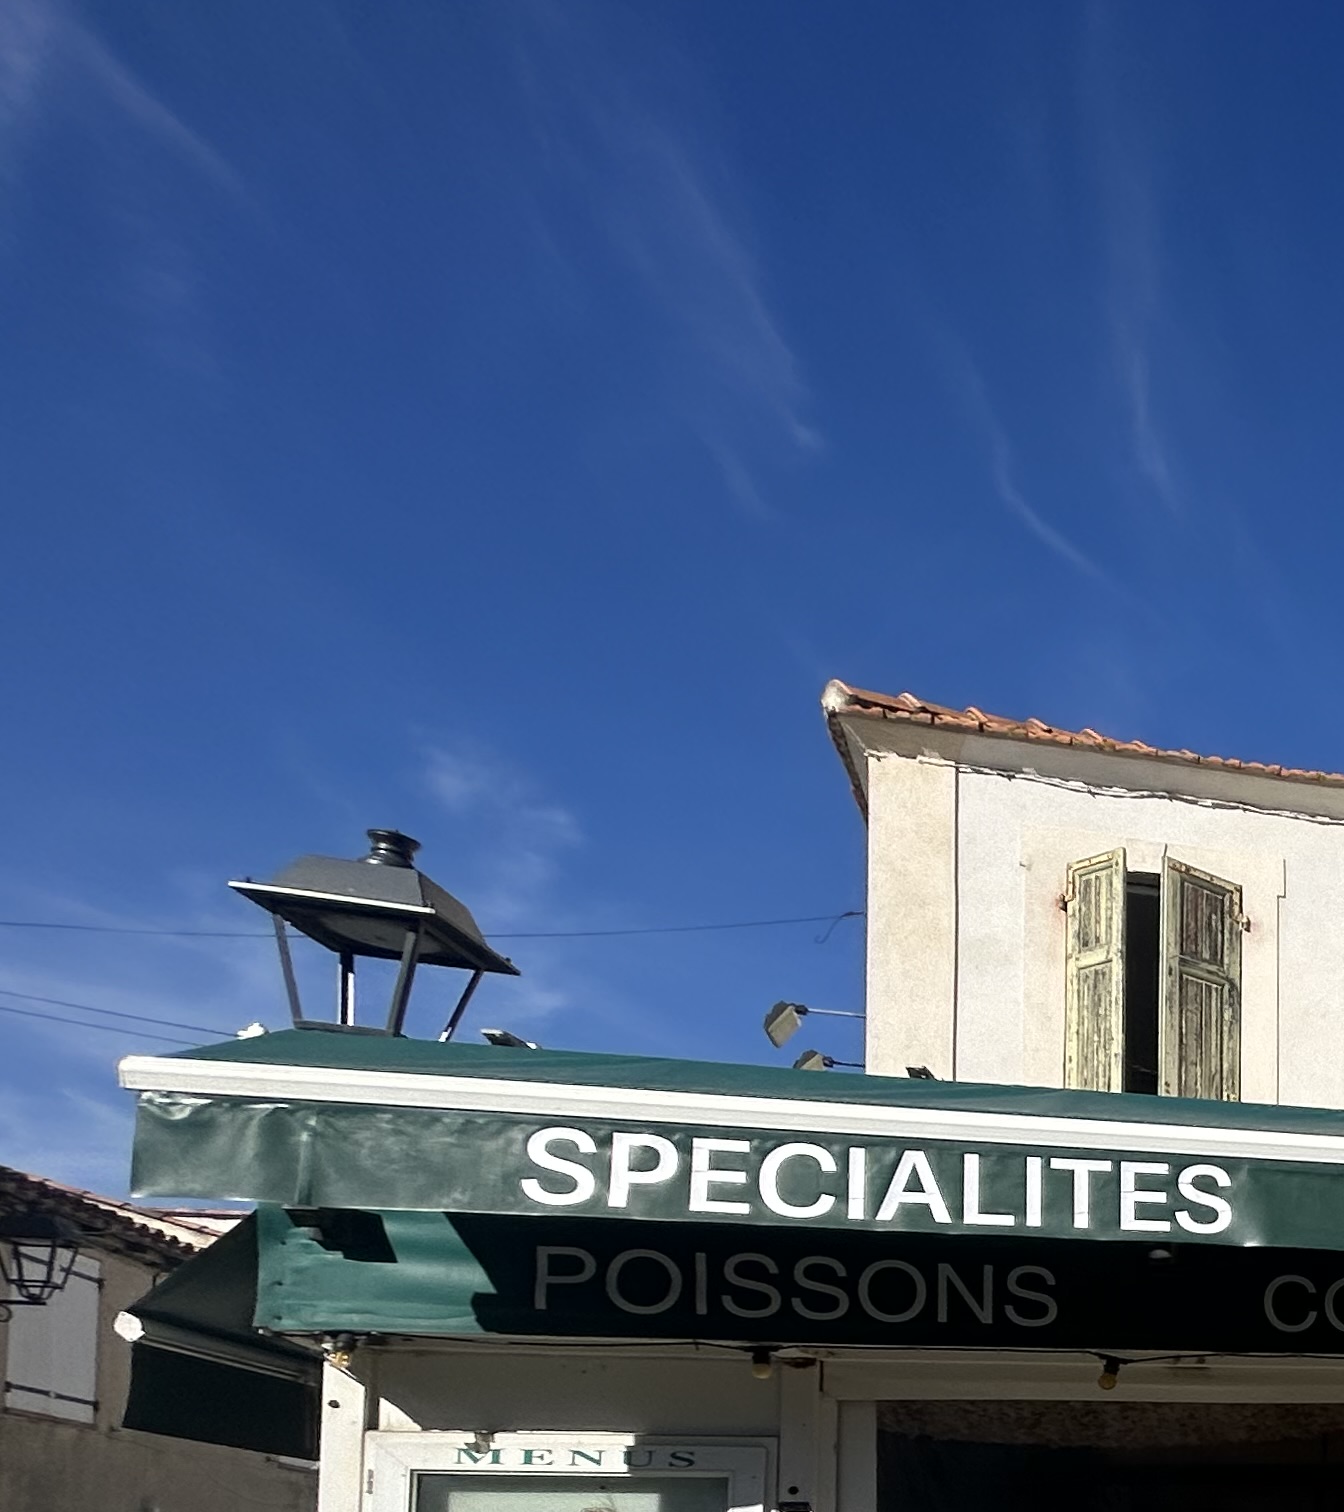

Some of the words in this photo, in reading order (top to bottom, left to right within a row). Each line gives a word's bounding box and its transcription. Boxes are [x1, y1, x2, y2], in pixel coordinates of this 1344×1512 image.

[519, 1125, 1233, 1235] SPECIALITES
[533, 1245, 1058, 1327] POISSONS
[455, 1447, 696, 1469] MENUS
